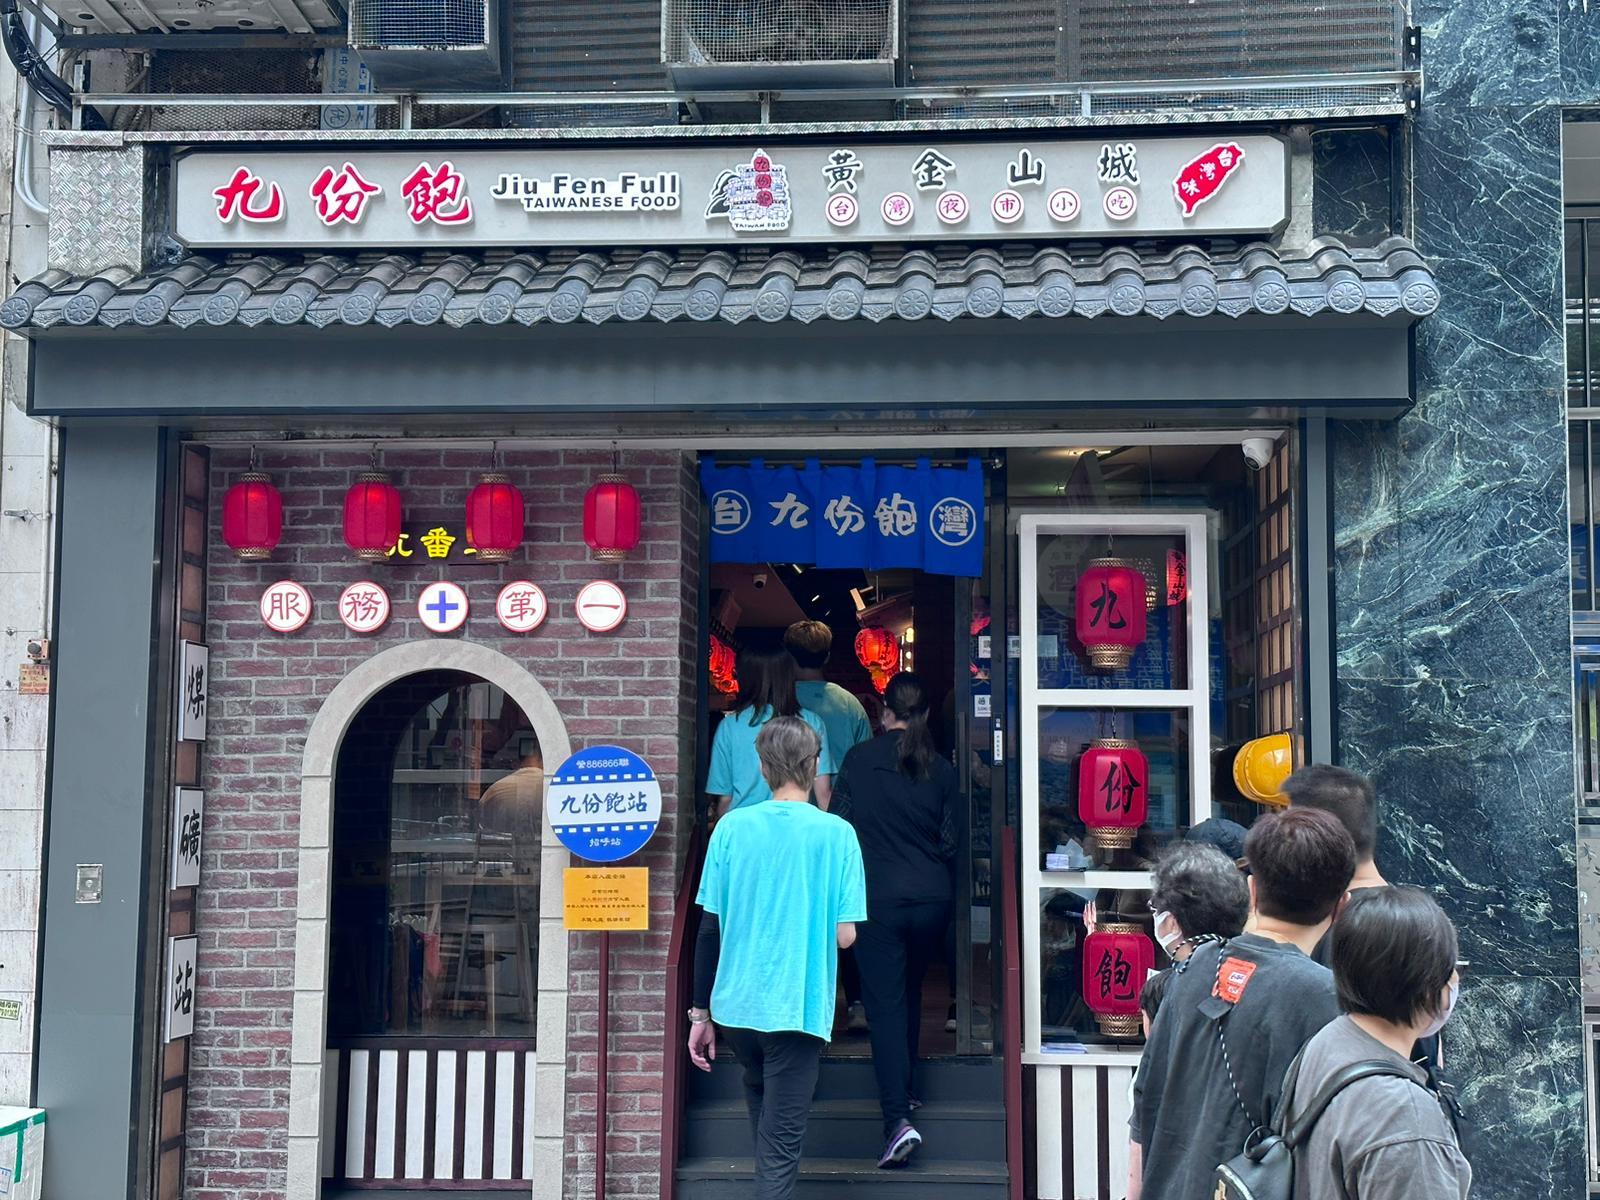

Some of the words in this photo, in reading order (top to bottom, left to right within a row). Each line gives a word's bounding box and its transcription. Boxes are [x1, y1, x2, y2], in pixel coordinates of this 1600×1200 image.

[493, 176, 538, 196] Jiu
[554, 175, 606, 195] Fen
[621, 174, 677, 194] Full
[825, 146, 1138, 189] 黃金山城
[212, 163, 471, 224] 九份飽
[524, 197, 624, 208] TAIWANESE
[631, 196, 677, 207] FOOD
[832, 192, 1131, 219] 台灣夜市小吃
[1088, 582, 1126, 630] 九
[560, 791, 648, 815] 九份飽站
[1099, 760, 1142, 816] 份
[1095, 946, 1136, 1001] 飽
